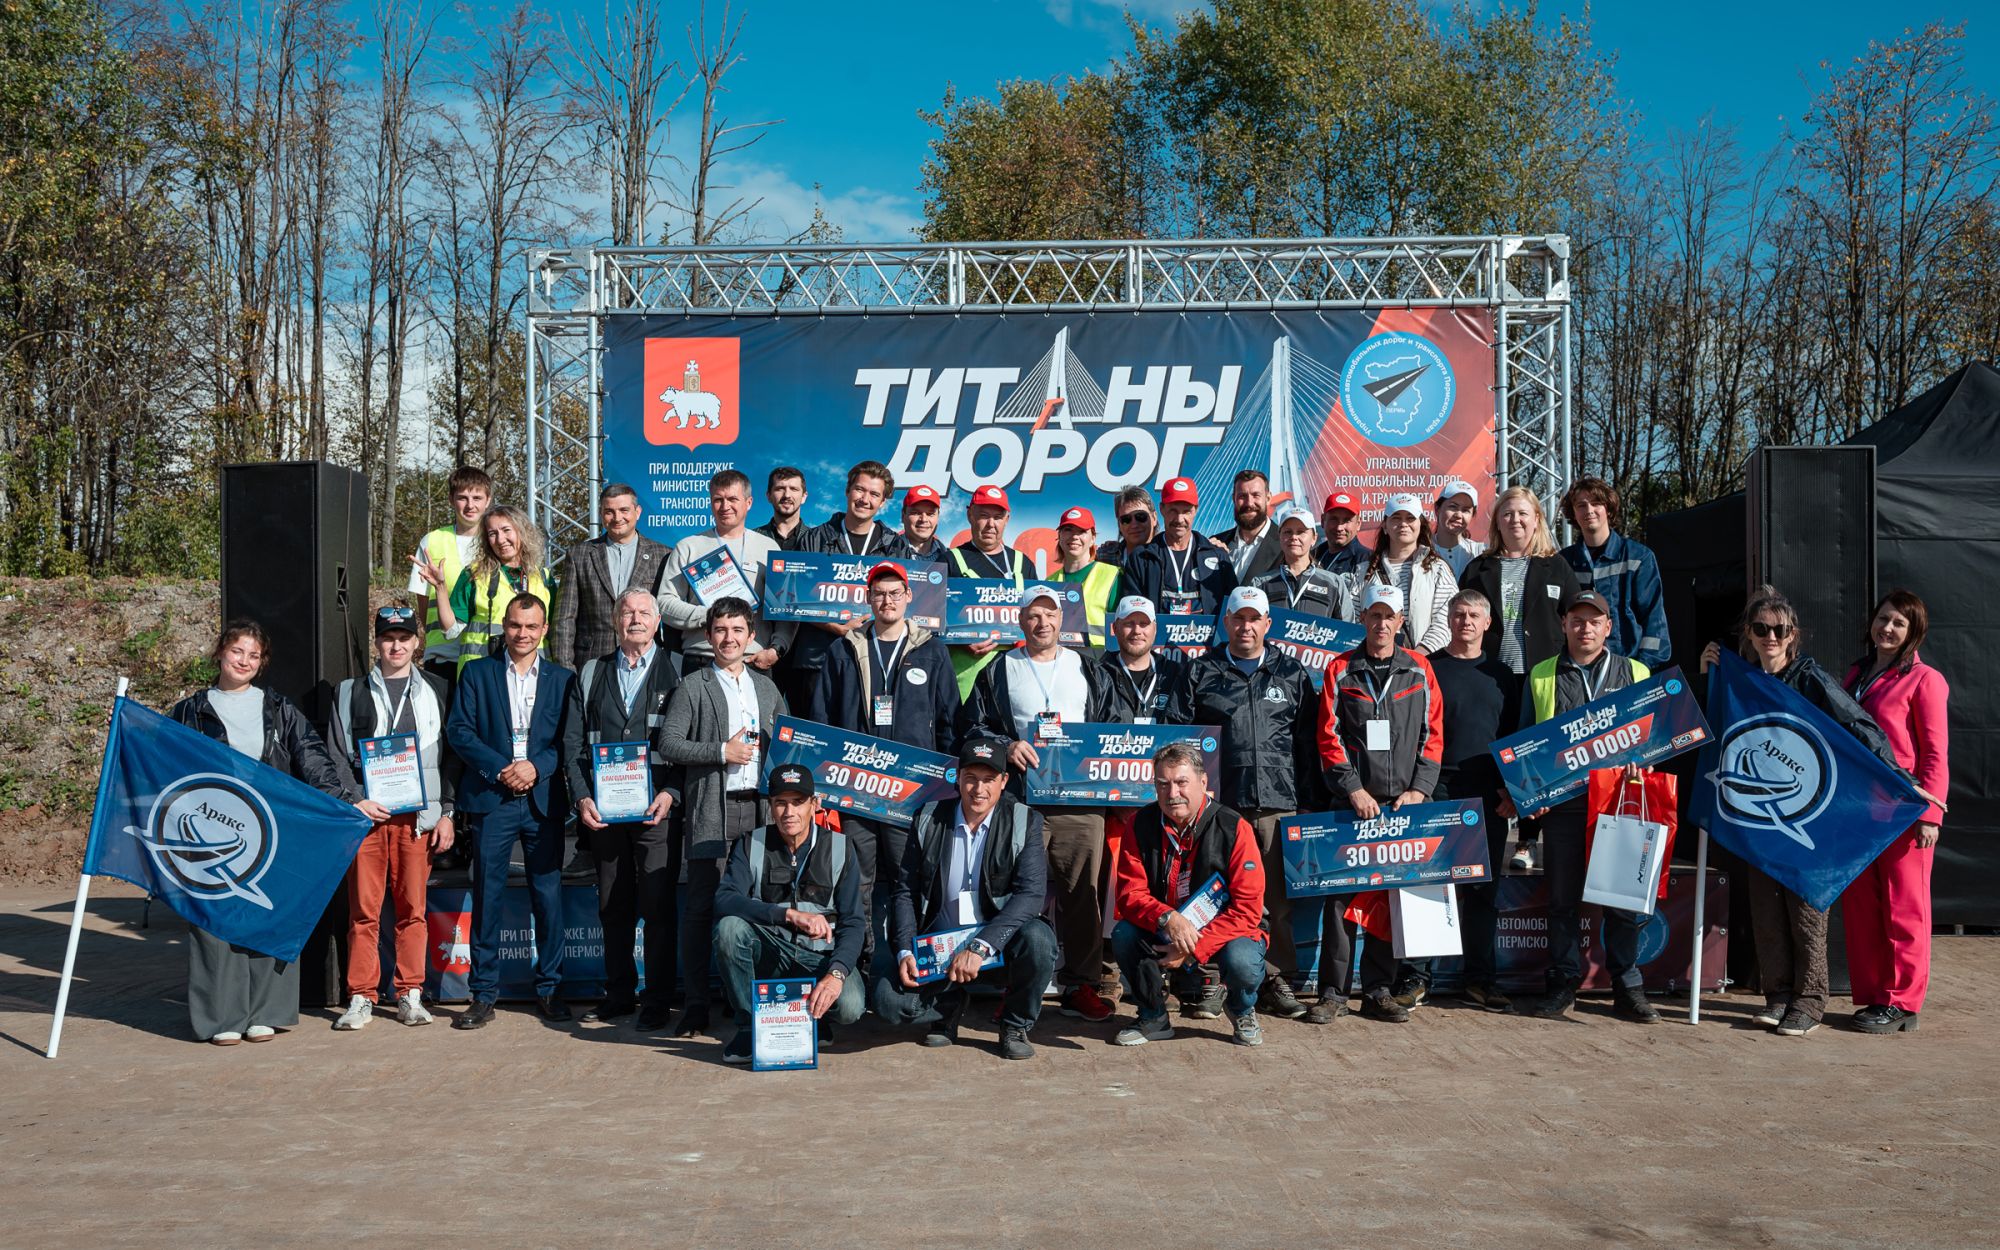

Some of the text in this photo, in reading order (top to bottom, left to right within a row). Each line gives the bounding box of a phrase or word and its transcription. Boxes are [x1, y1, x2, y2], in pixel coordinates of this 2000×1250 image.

[1383, 337, 1407, 346] дорог
[854, 335, 1243, 428] ТИТАНЫ
[648, 462, 670, 475] ПРИ
[887, 427, 1226, 497] ДОРОГ
[1365, 457, 1431, 471] УПРАВЛЕНИЕ
[1334, 475, 1426, 488] АВТОМОБИЛЬНЫХ
[1362, 493, 1369, 505] И
[648, 514, 707, 527] ПЕРМСКОГО
[818, 584, 848, 602] 100
[978, 594, 1022, 603] ДОРОГ
[966, 607, 995, 624] 100
[1284, 630, 1334, 646] ДОРОГ
[1285, 620, 1338, 639] ТИТАНЫ
[1560, 704, 1617, 735] ТИТАНЫ
[1098, 731, 1154, 745] ТИТАНЫ
[1569, 715, 1616, 744] ДОРОГ
[843, 741, 899, 765] ТИТАНЫ
[1100, 744, 1152, 755] ДОРОГ
[1758, 739, 1805, 775] Аракс
[841, 752, 895, 771] ДОРОГ
[1564, 748, 1590, 771] 50
[825, 764, 851, 787] 30
[1088, 760, 1112, 781] 50
[195, 801, 246, 832] Аракс
[1352, 815, 1410, 830] ТИТАНЫ
[1356, 825, 1409, 841] ДОРОГ
[1346, 846, 1370, 867] 30
[788, 1001, 801, 1012] 280
